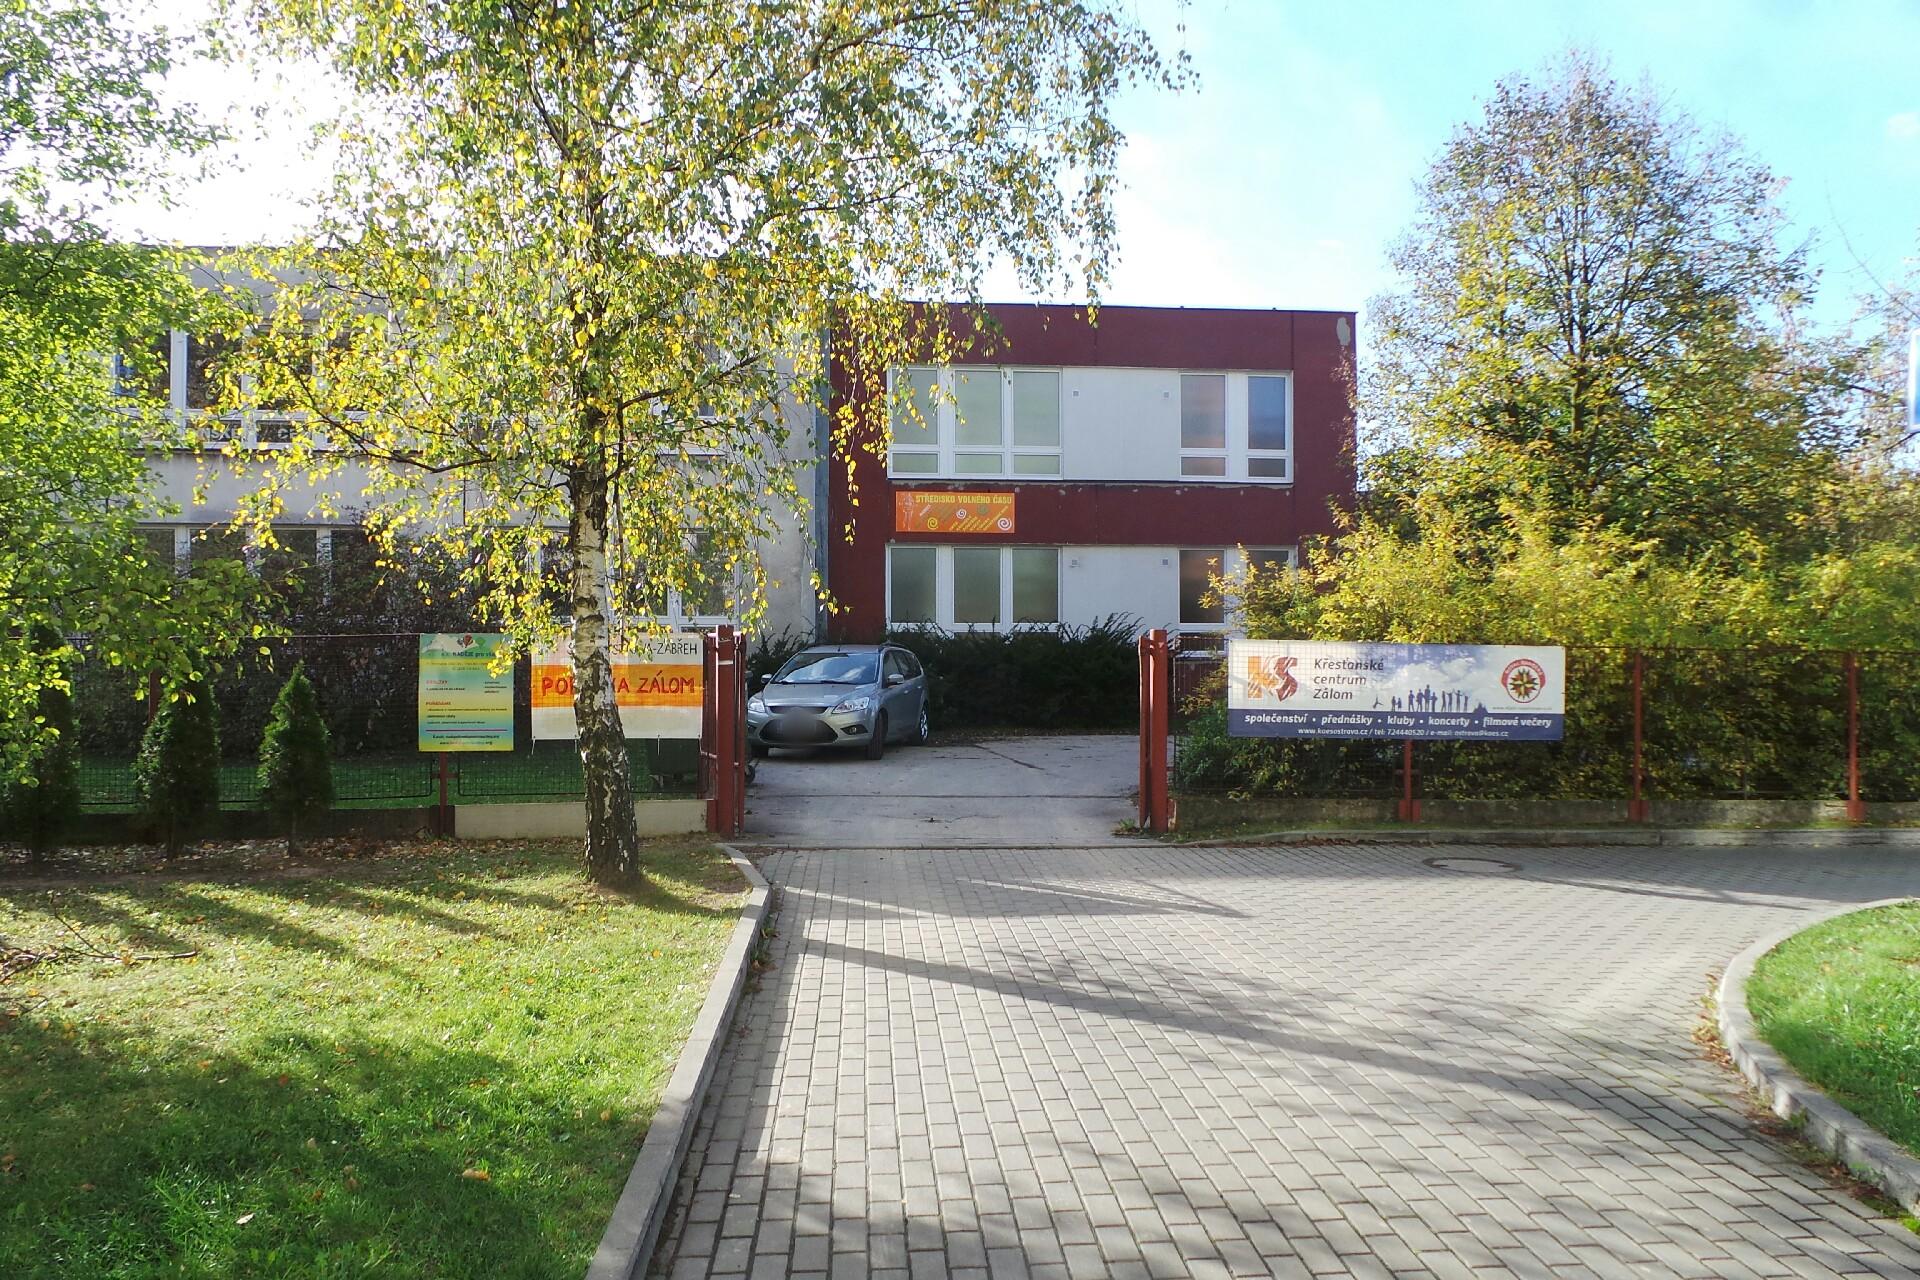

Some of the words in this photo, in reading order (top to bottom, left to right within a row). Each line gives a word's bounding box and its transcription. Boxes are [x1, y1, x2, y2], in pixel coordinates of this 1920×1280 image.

[637, 670, 695, 694] ZÁLOM
[1313, 674, 1367, 686] centrum
[1313, 687, 1353, 700] Zálom
[1244, 713, 1308, 724] společenství
[1321, 714, 1373, 726] přednášky
[1387, 715, 1415, 727] kluby
[1428, 716, 1470, 727] koncerty
[1482, 716, 1518, 728] filmové
[1520, 717, 1552, 729] večery
